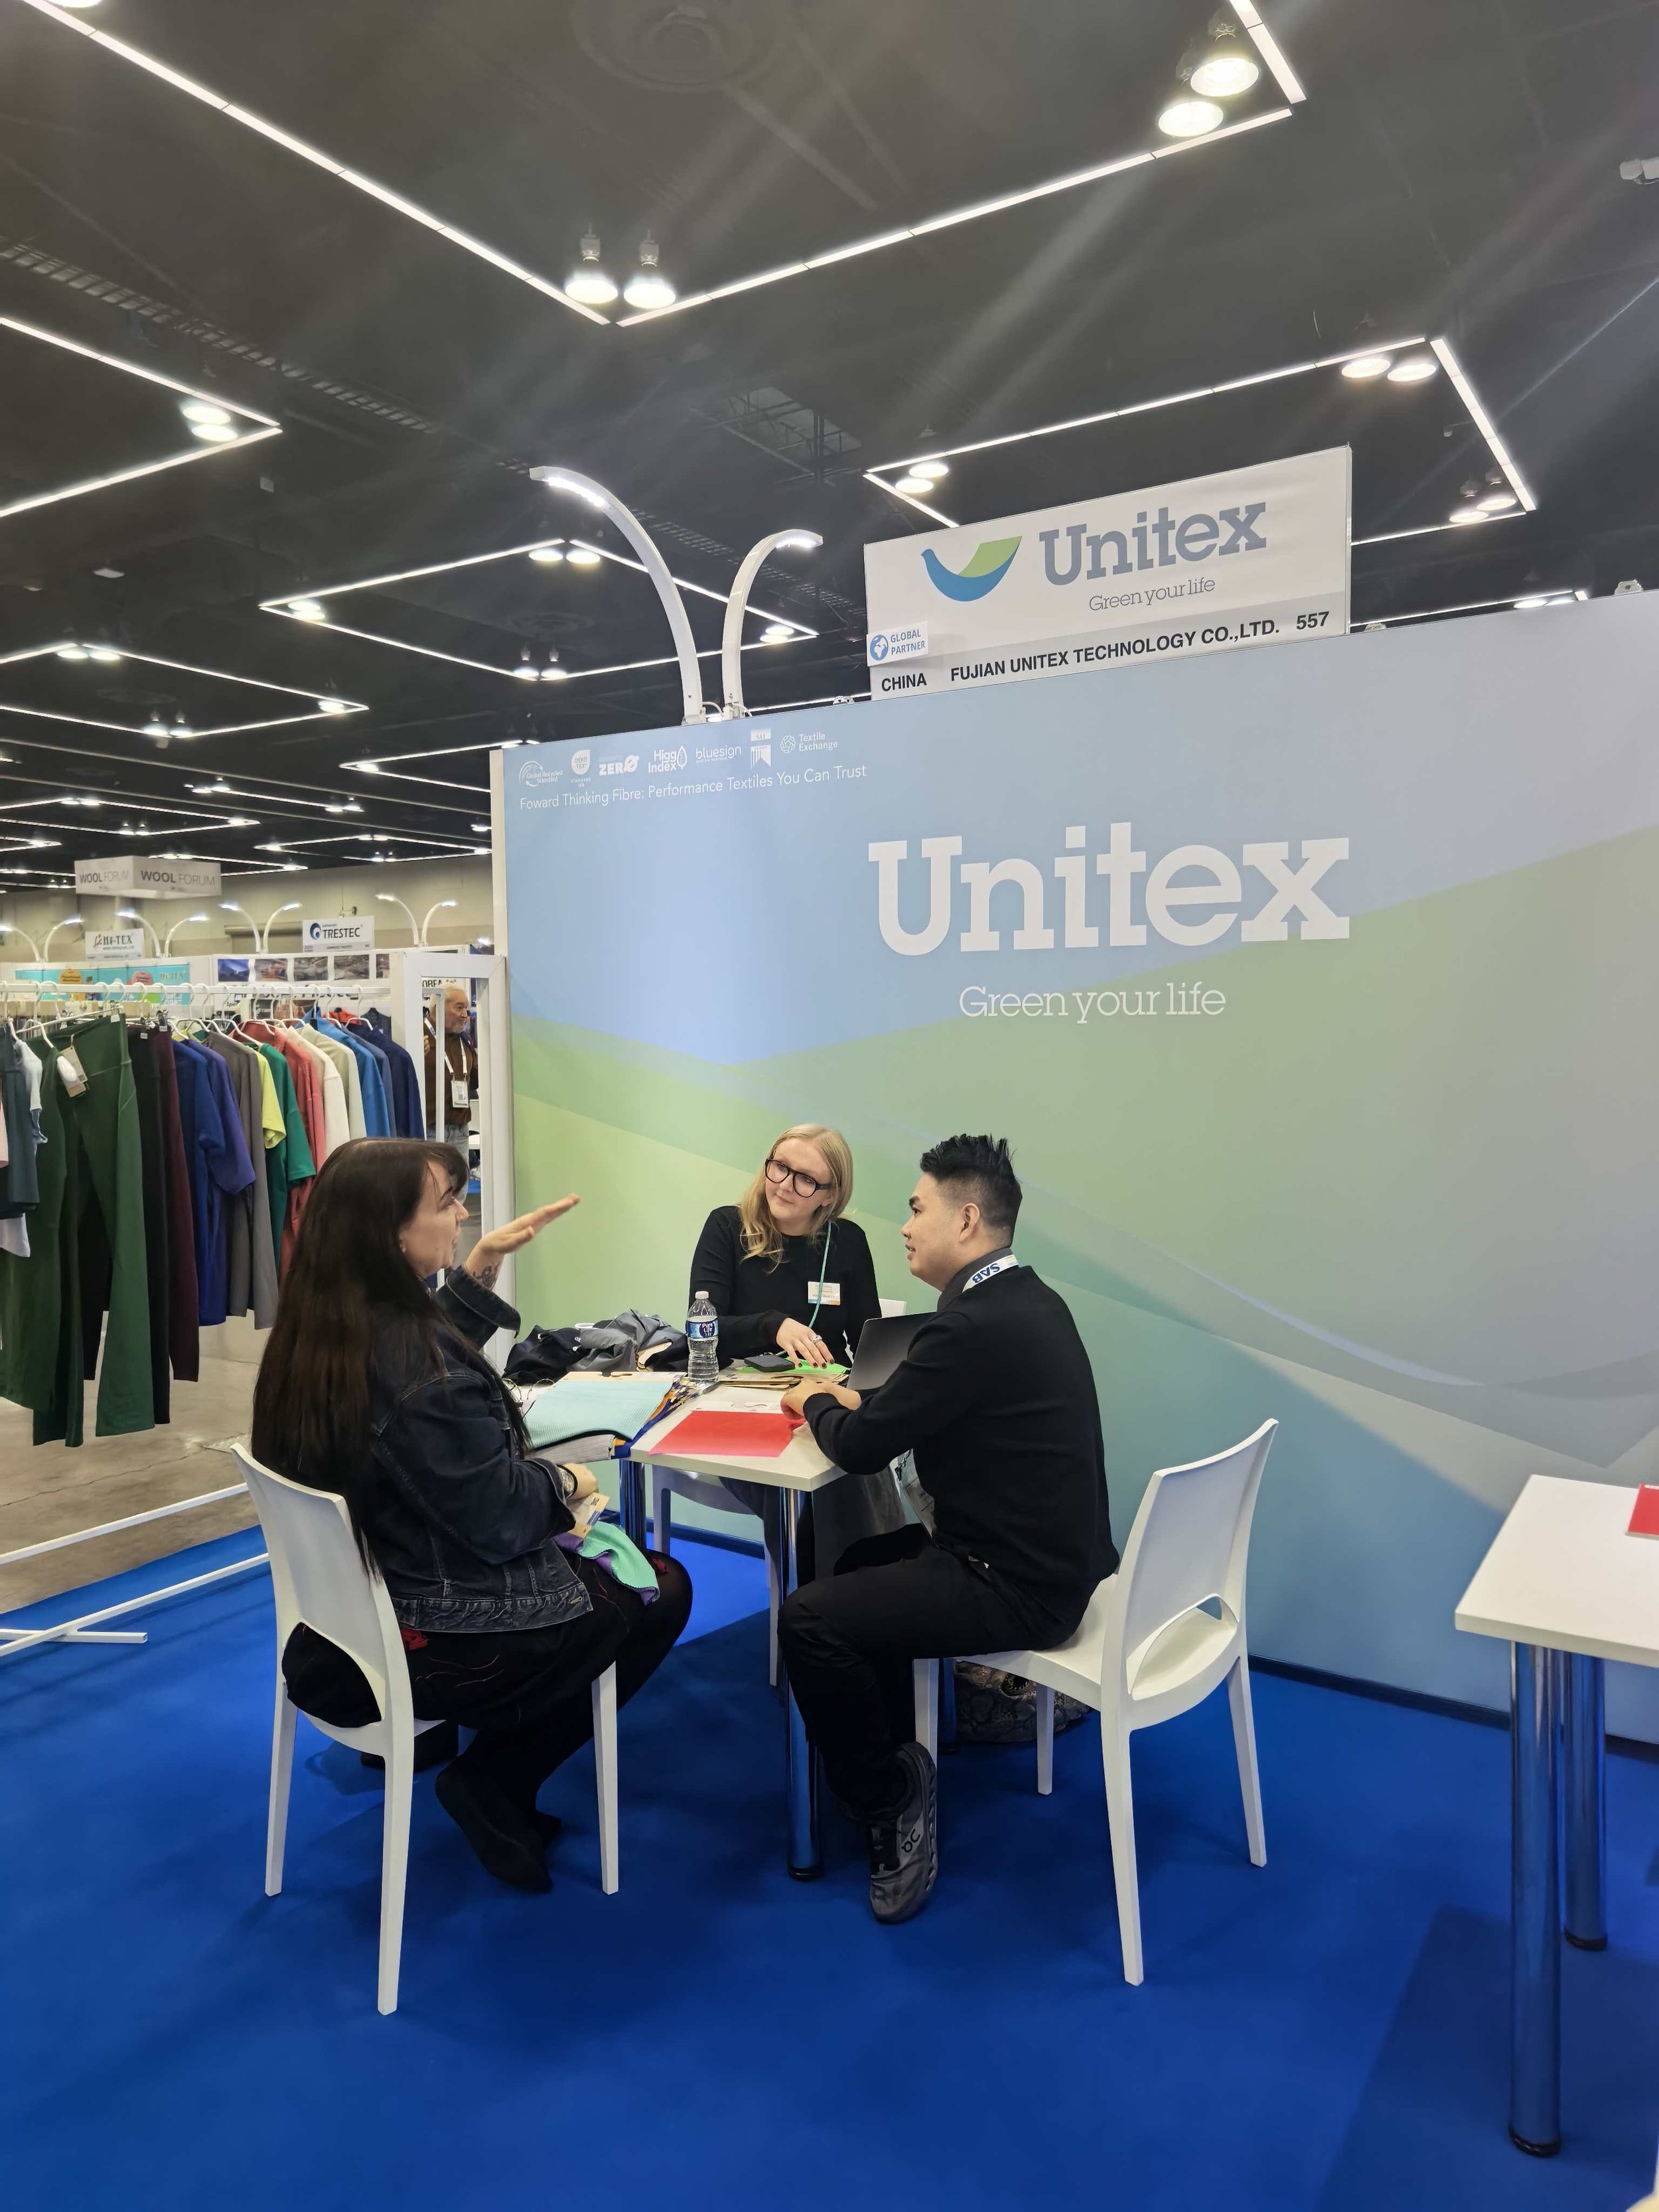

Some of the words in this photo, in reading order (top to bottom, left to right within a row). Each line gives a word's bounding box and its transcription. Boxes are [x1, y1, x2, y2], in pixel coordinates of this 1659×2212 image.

[1039, 502, 1267, 585] Unitex
[1089, 592, 1143, 611] Green
[1144, 584, 1185, 606] your
[1188, 577, 1215, 595] life
[891, 628, 921, 642] GLOBAL
[881, 673, 927, 692] CHINA
[951, 660, 1005, 681] FUJIAN
[1011, 651, 1068, 672] UNITEX
[1073, 630, 1196, 663] TECHNOLOGY
[1201, 619, 1279, 644] CO.,LTD.
[1296, 611, 1330, 630] 557
[891, 640, 925, 656] PARTNER
[799, 731, 826, 742] Textile
[695, 745, 742, 759] bluesign
[799, 741, 838, 752] Exchange
[654, 749, 677, 763] Higg
[648, 762, 676, 773] Index
[520, 794, 559, 810] Foward
[562, 790, 609, 806] Thinking
[613, 787, 644, 801] Fibre:
[648, 782, 723, 798] Performance
[727, 773, 773, 791] Textiles
[776, 771, 800, 785] You
[804, 769, 830, 782] Can
[833, 765, 867, 780] Trust
[80, 872, 102, 883] WOOL
[104, 870, 129, 882] FORUM
[141, 870, 177, 883] WOOL
[179, 873, 215, 886] FORUM
[868, 822, 1350, 956] Unitex
[322, 927, 360, 939] TRESTEC
[960, 986, 1068, 1017] Green
[1072, 990, 1161, 1024] your
[1166, 981, 1226, 1015] life
